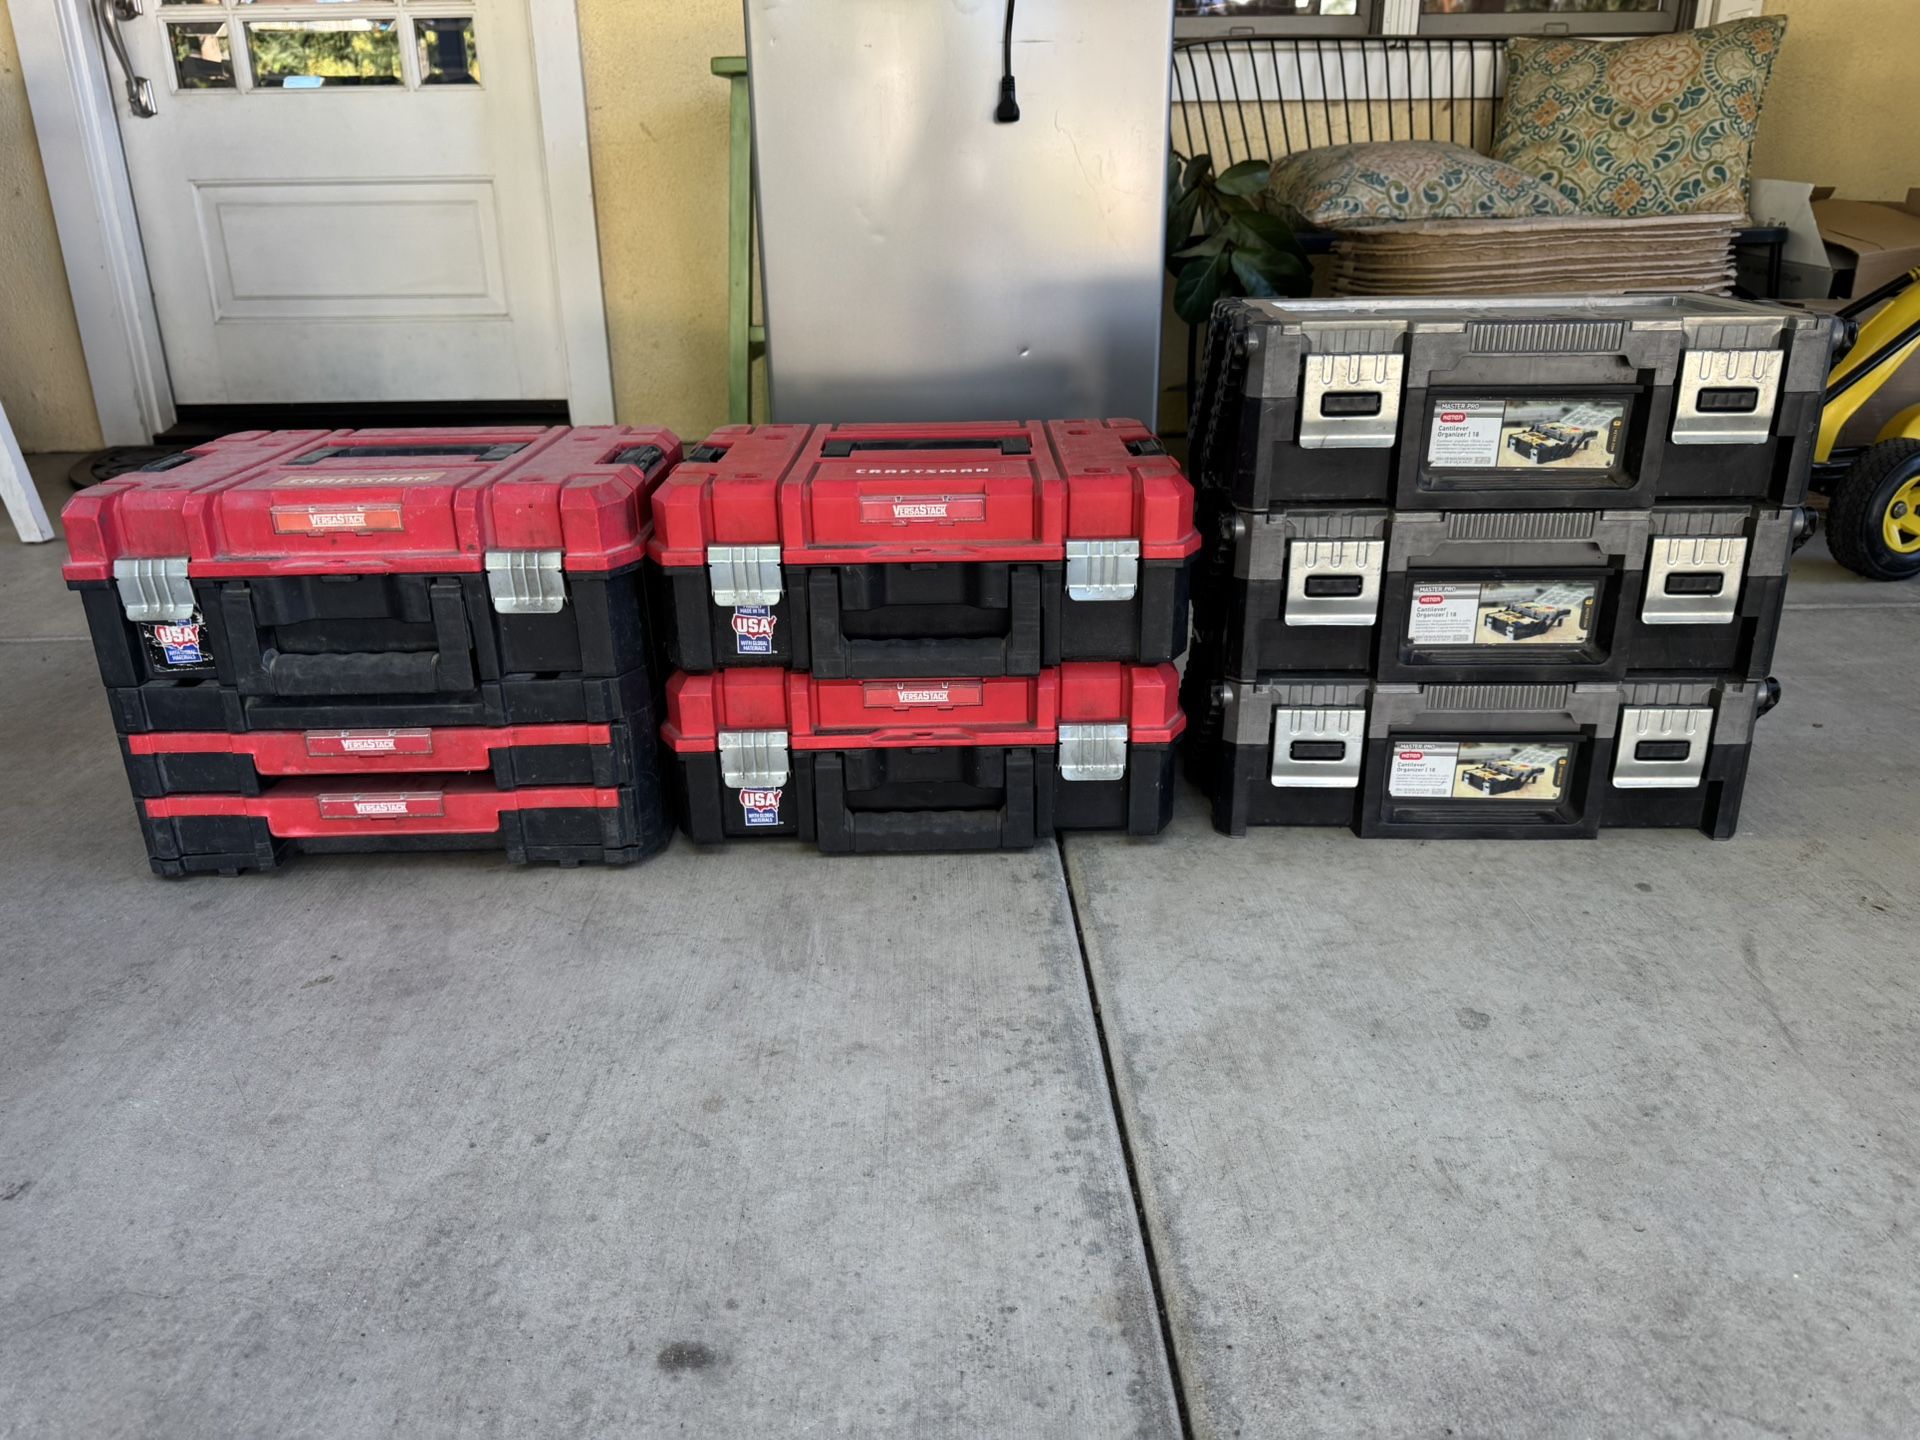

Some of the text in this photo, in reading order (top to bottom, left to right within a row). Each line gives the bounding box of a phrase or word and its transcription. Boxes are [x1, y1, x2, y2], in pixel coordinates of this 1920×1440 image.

[736, 617, 771, 633] USA
[159, 627, 196, 643] USA
[743, 792, 776, 806] USA
